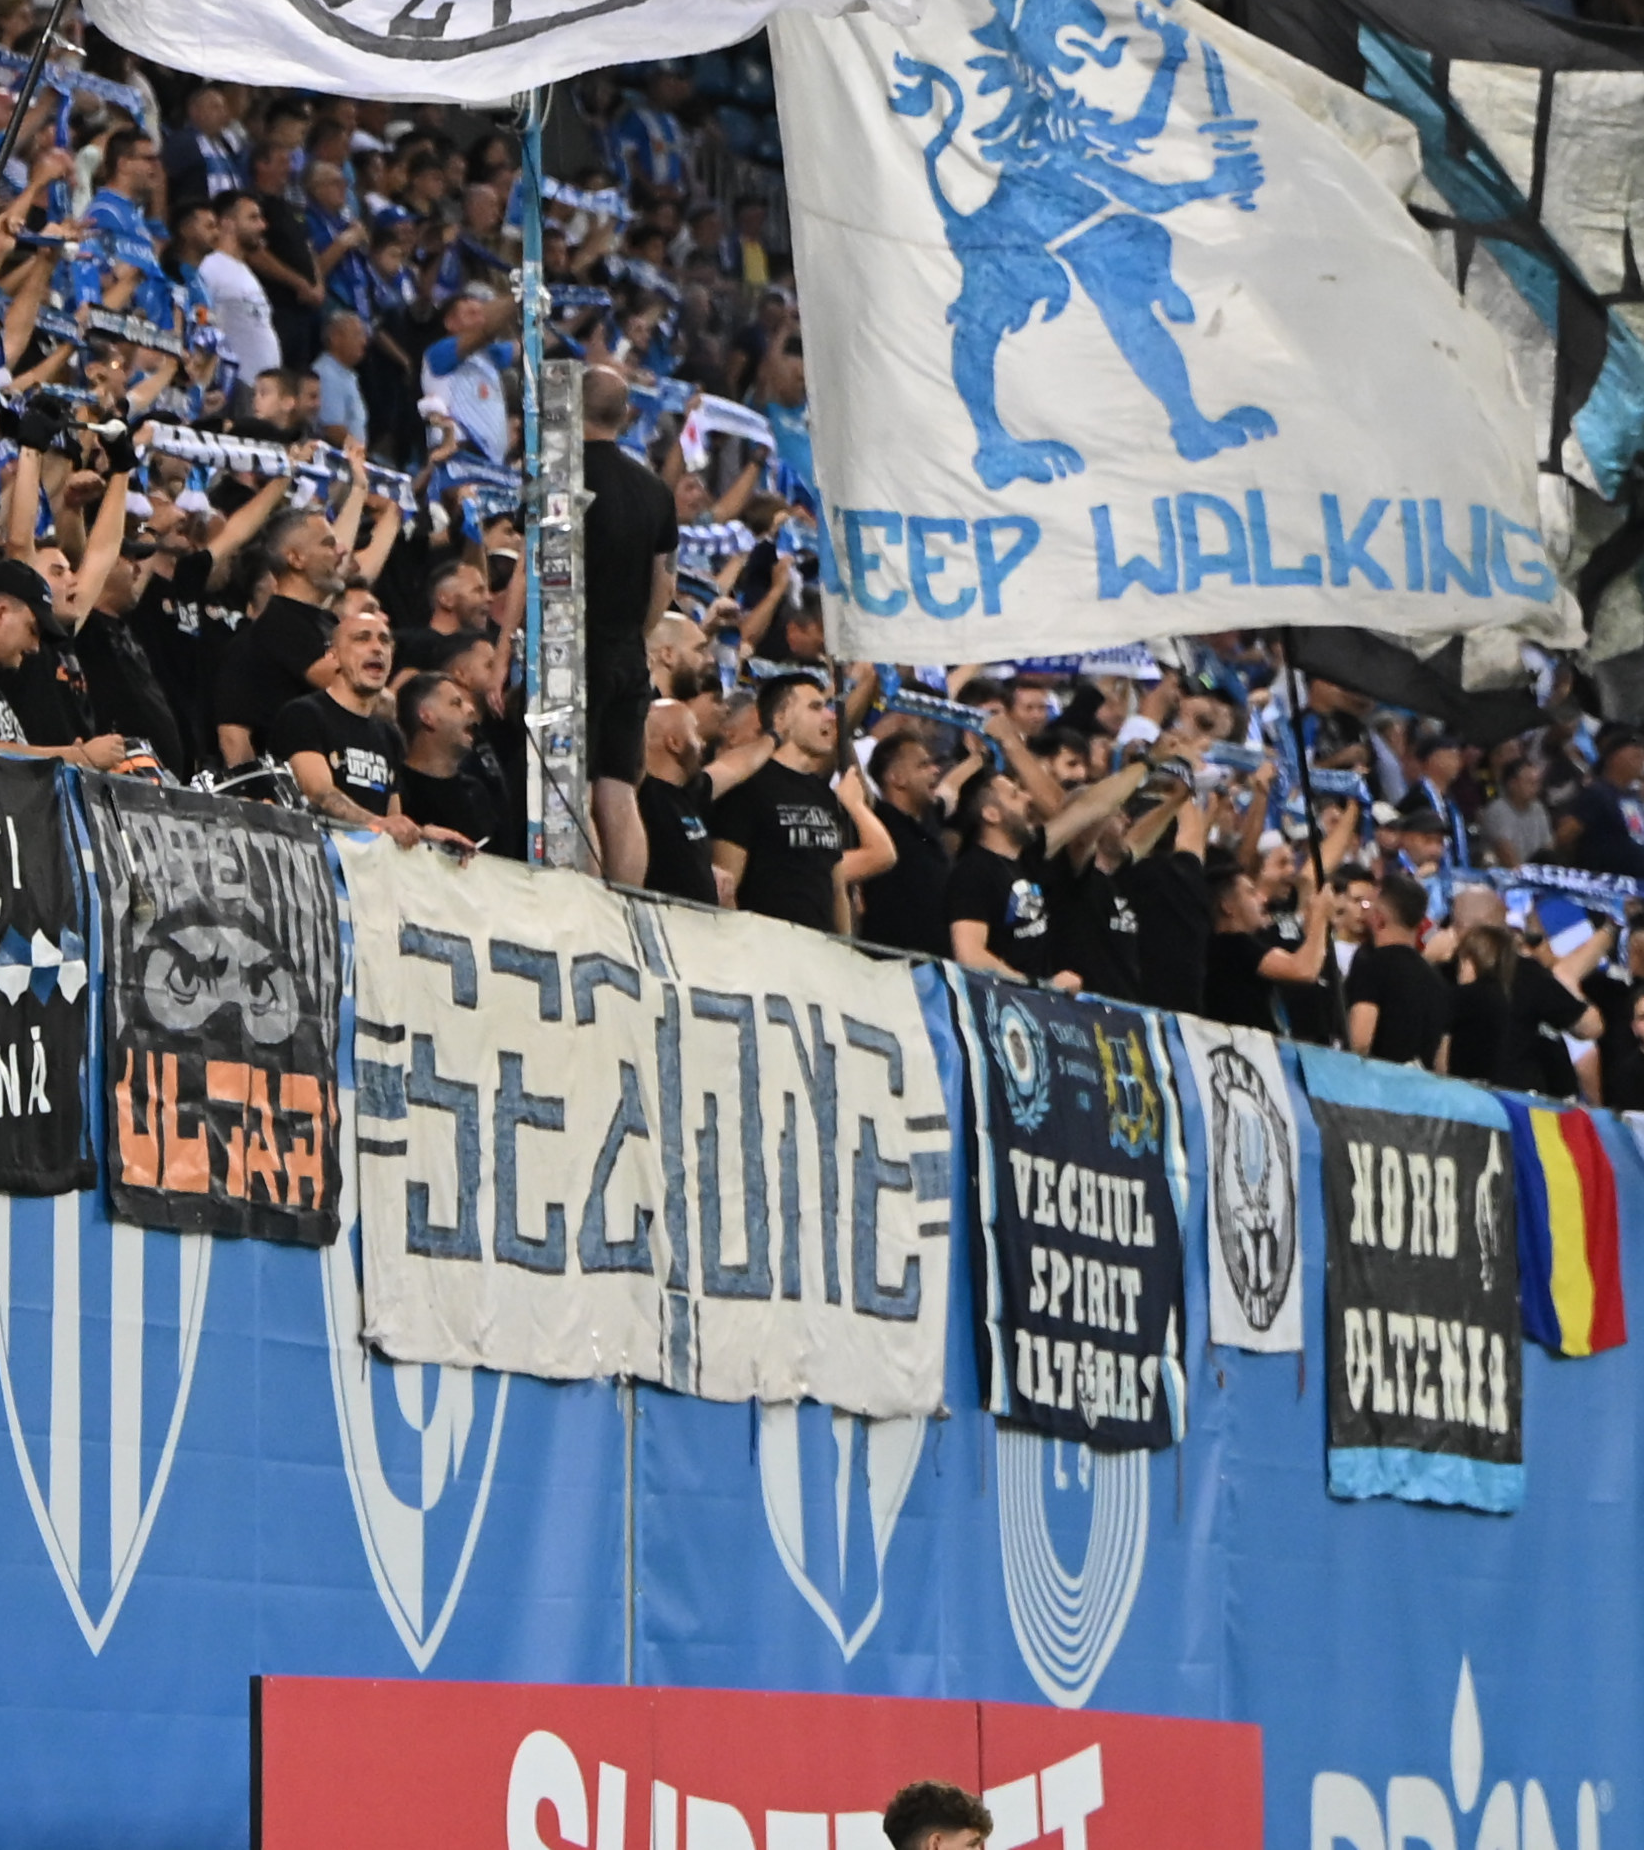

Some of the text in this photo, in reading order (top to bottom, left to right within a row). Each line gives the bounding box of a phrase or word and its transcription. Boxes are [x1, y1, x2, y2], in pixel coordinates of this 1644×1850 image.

[821, 486, 1555, 619] EEP WALKING
[1008, 1146, 1156, 1248] VECHIUL
[1347, 1140, 1459, 1260] NORD
[1028, 1245, 1143, 1335] SPIRIT
